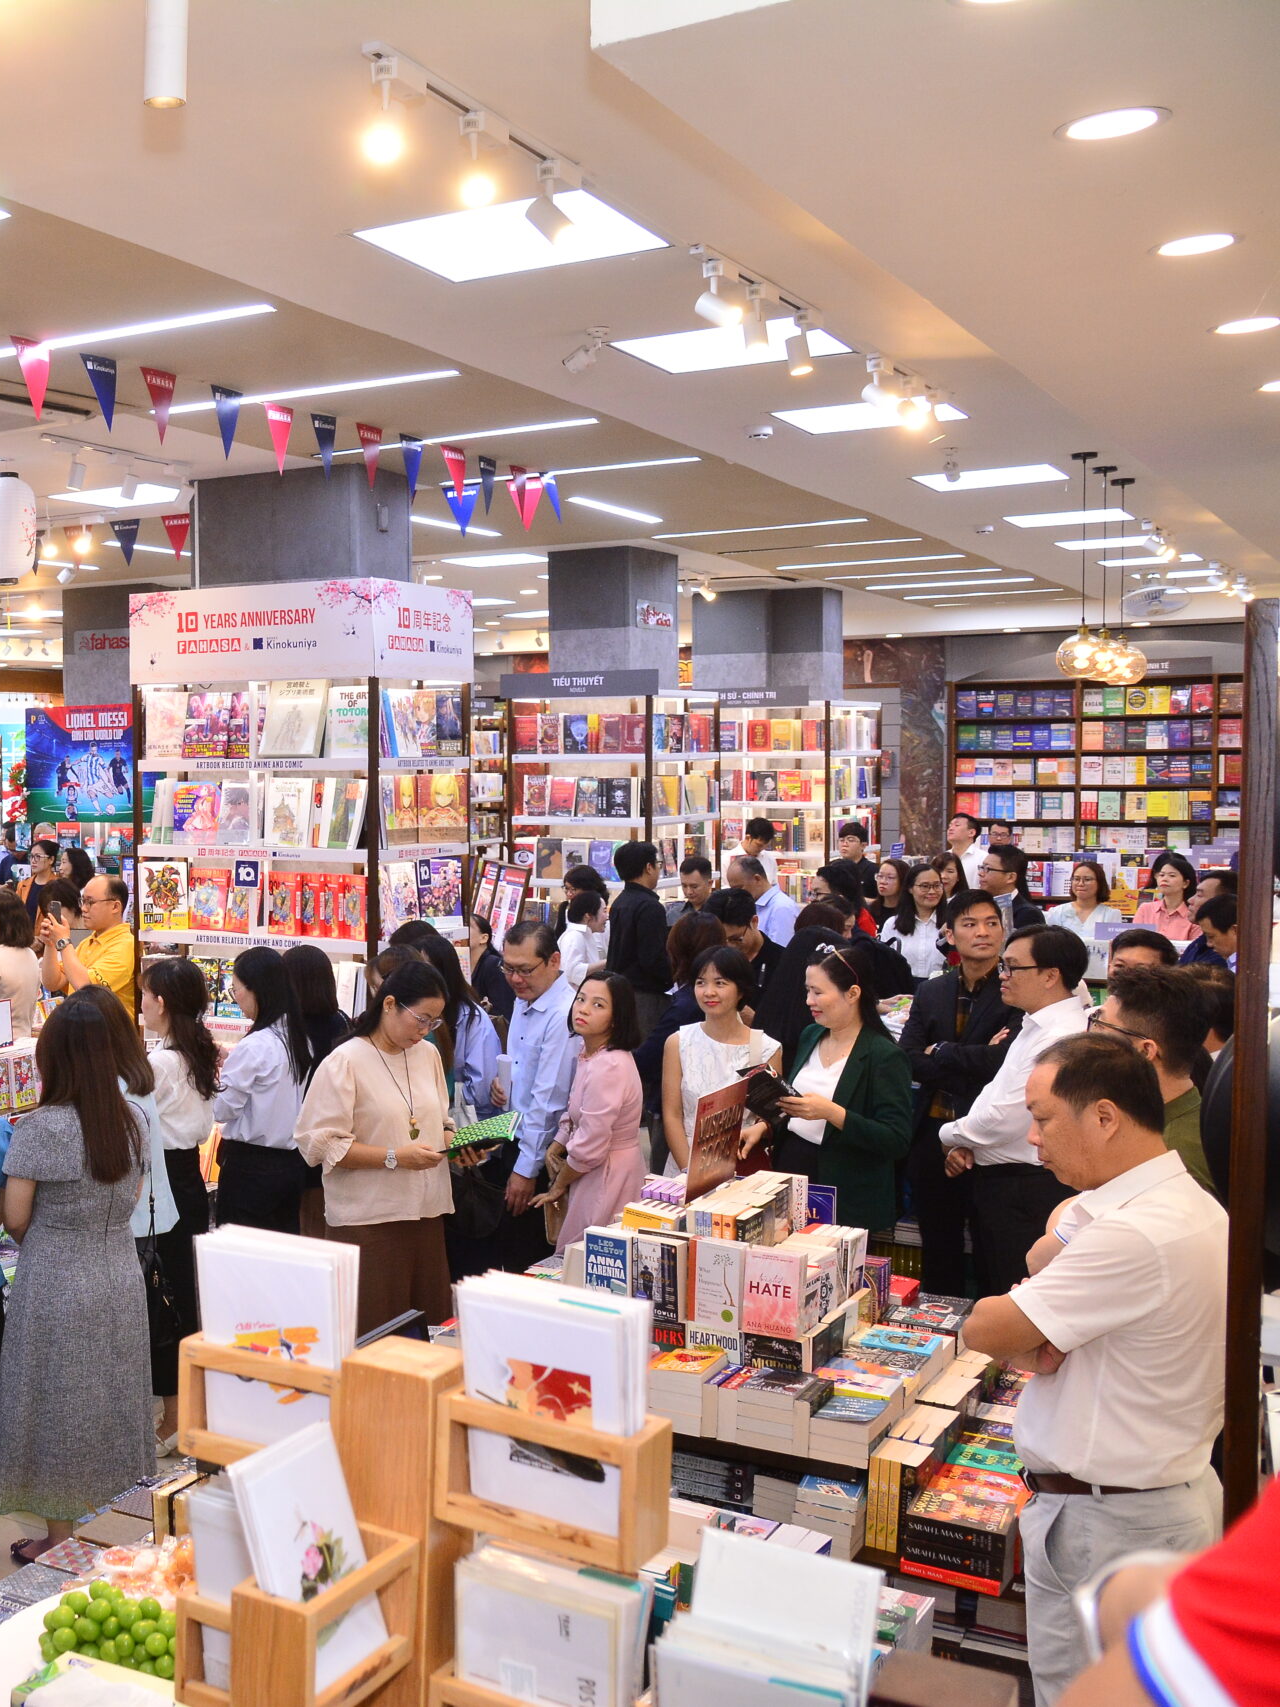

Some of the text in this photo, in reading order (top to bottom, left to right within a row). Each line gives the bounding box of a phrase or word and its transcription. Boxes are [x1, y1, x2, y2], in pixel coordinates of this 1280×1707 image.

[177, 608, 316, 633] 10 YEARS ANNIVERSARY
[397, 607, 452, 633] 10 周年記念
[178, 638, 317, 655] FAHASA Kinokuniya
[388, 635, 462, 655] FAHASA Kinokuniya
[552, 675, 604, 687] TIỂU THUYẾT
[340, 692, 354, 700] THE
[742, 691, 764, 699] CHÍNH
[347, 700, 357, 708] OF
[65, 711, 128, 729] LIONEL MESSI
[196, 761, 303, 769] ARTBOOK RELATED TO ANIME AND COMIC
[196, 934, 220, 944] ARTBOOK
[221, 935, 243, 945] RELATED
[253, 938, 270, 947] ANIME
[272, 939, 283, 947] AND
[588, 1243, 624, 1256] TOLSTOY
[598, 1239, 614, 1247] LEO
[588, 1254, 624, 1268] ANNA
[587, 1262, 625, 1280] KARENINA
[749, 1281, 792, 1299] HATE
[654, 1309, 677, 1318] TOWLES
[746, 1321, 792, 1334] ANA HUANG
[655, 1329, 685, 1346] DERS
[689, 1330, 738, 1351] HEARTWOOD
[908, 1522, 934, 1536] SARAH
[941, 1530, 964, 1541] MAAS
[906, 1545, 961, 1565] SARAH MAAS
[904, 1565, 943, 1579] SARAH MAAS
